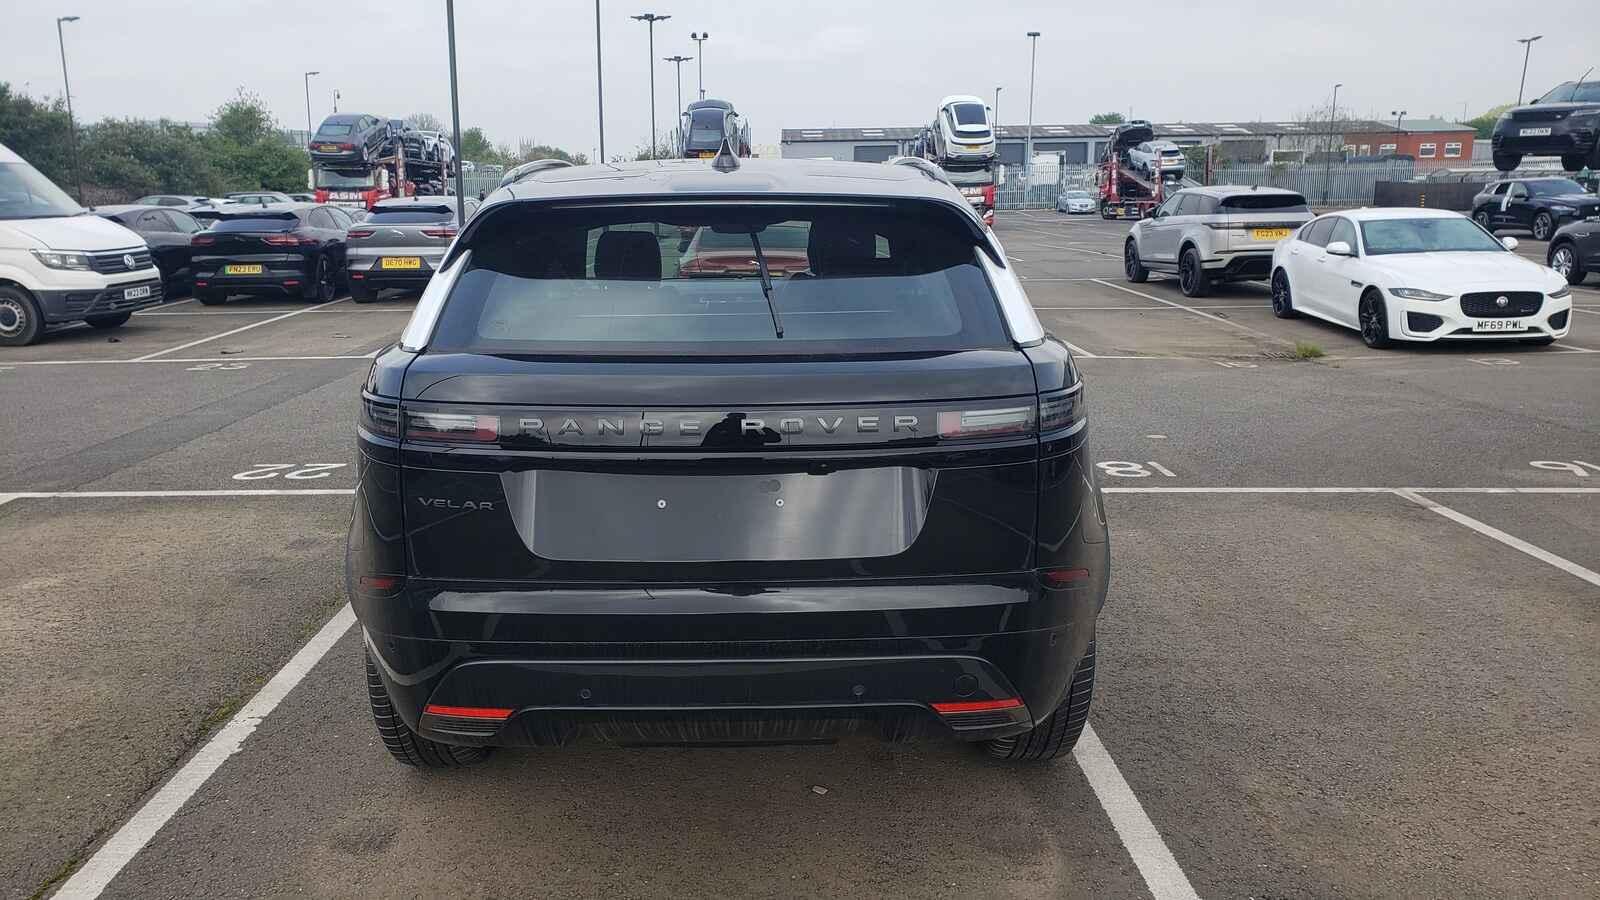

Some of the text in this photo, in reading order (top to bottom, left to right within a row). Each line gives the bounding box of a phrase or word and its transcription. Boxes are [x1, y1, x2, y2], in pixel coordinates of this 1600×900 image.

[328, 191, 363, 200] ASM
[1477, 320, 1525, 330] MF69 PWL
[519, 415, 921, 437] RANGE ROVER
[418, 497, 495, 511] VELAR
